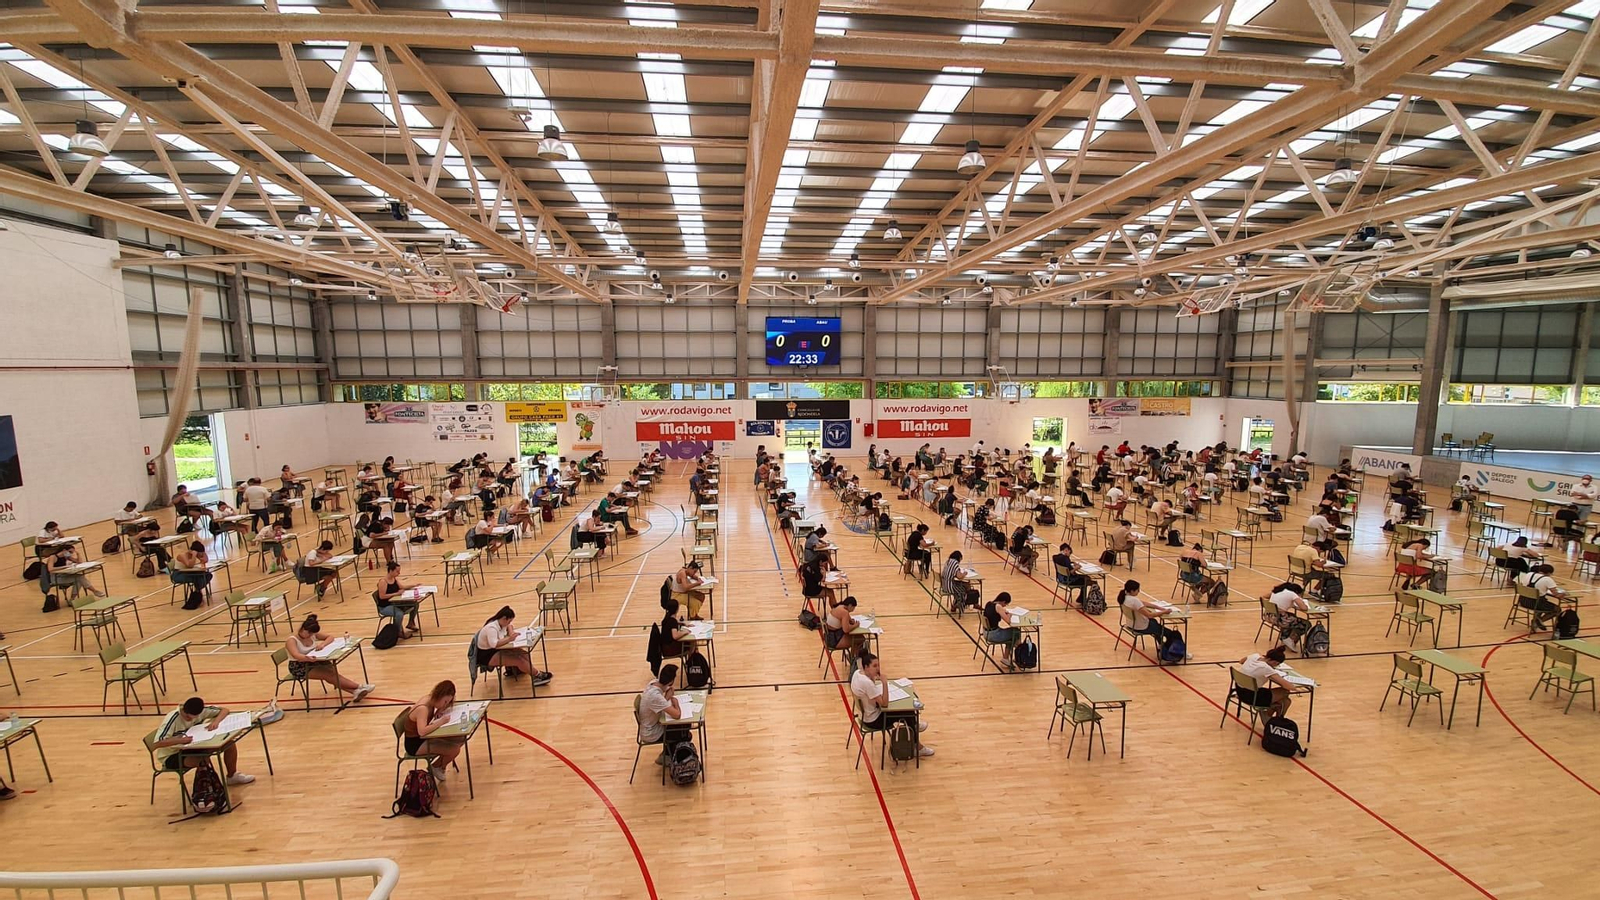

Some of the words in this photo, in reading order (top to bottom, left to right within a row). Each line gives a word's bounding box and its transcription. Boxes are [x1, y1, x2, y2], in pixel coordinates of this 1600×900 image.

[775, 334, 785, 347] 0
[821, 334, 831, 347] 0
[789, 354, 818, 364] 22:33
[641, 405, 732, 417] www.rodavigo.net
[883, 403, 968, 415] www.rodavigo.net
[659, 422, 712, 435] Mahou
[900, 420, 949, 432] Mahou
[1363, 456, 1412, 473] ABANC
[1490, 477, 1515, 485] GALEGO
[1491, 472, 1517, 480] DEPORTE
[1269, 724, 1296, 740] VANS
